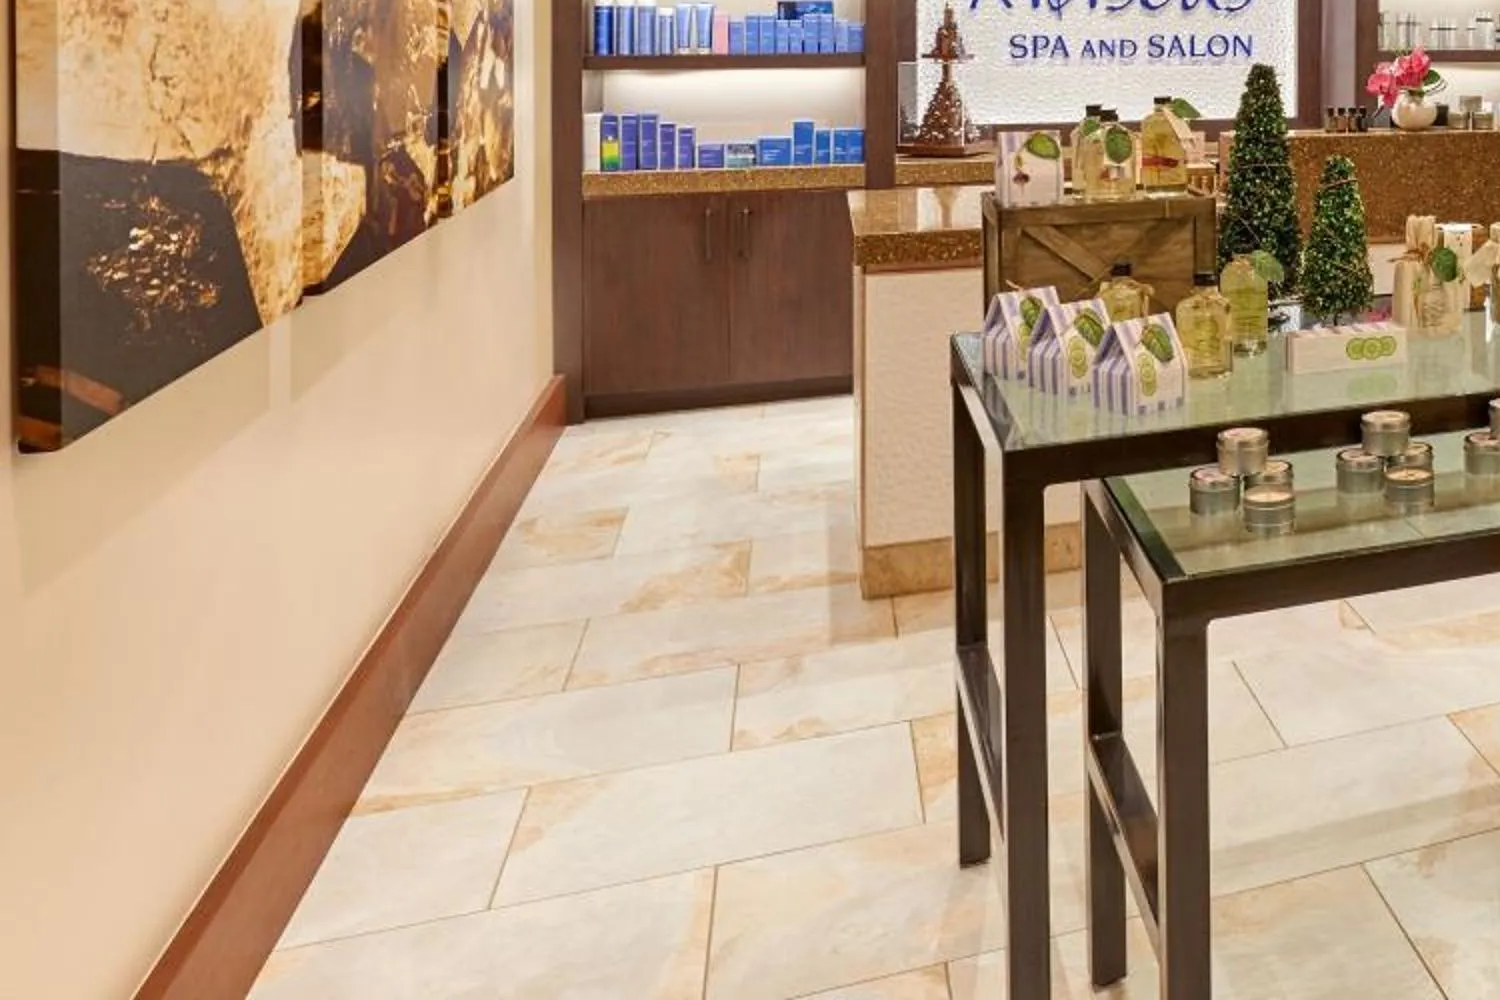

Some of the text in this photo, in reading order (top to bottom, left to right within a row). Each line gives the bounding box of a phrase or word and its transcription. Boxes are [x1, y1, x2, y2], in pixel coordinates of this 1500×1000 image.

[1009, 35, 1254, 59] SPA AND SALON
